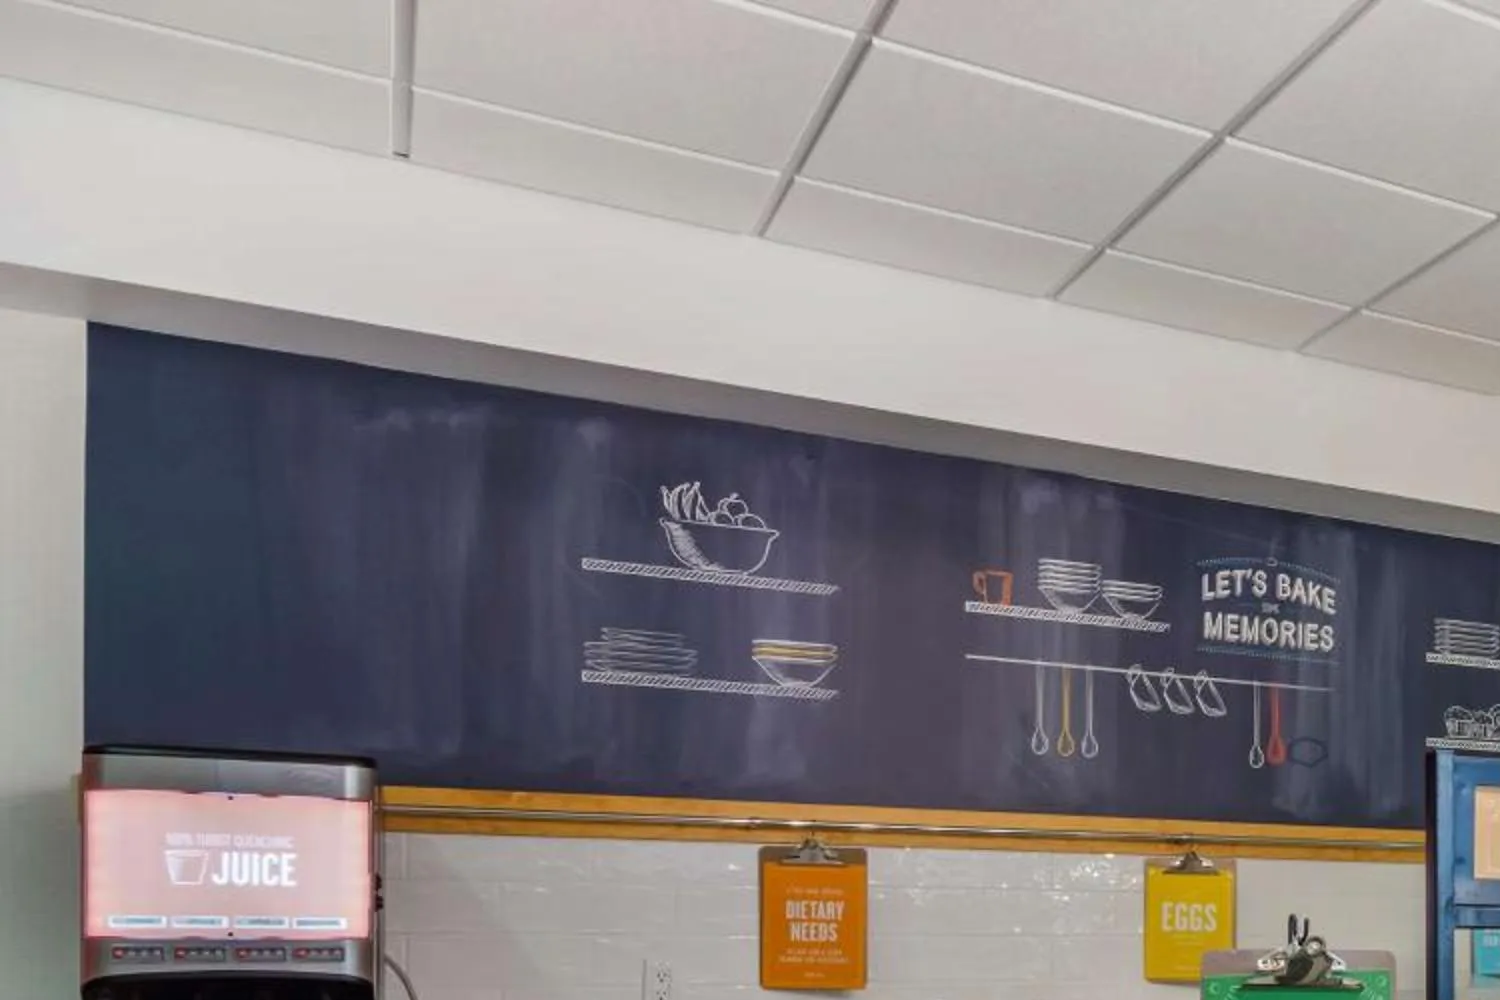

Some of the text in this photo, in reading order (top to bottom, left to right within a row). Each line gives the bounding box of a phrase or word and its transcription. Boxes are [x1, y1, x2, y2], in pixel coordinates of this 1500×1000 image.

[1201, 568, 1336, 615] LET'S BAKE
[1203, 611, 1334, 652] MEMORIES
[211, 851, 297, 887] JUICE
[785, 900, 845, 921] DIETARY
[1161, 901, 1217, 932] EGGS
[790, 921, 838, 942] NEEDS
